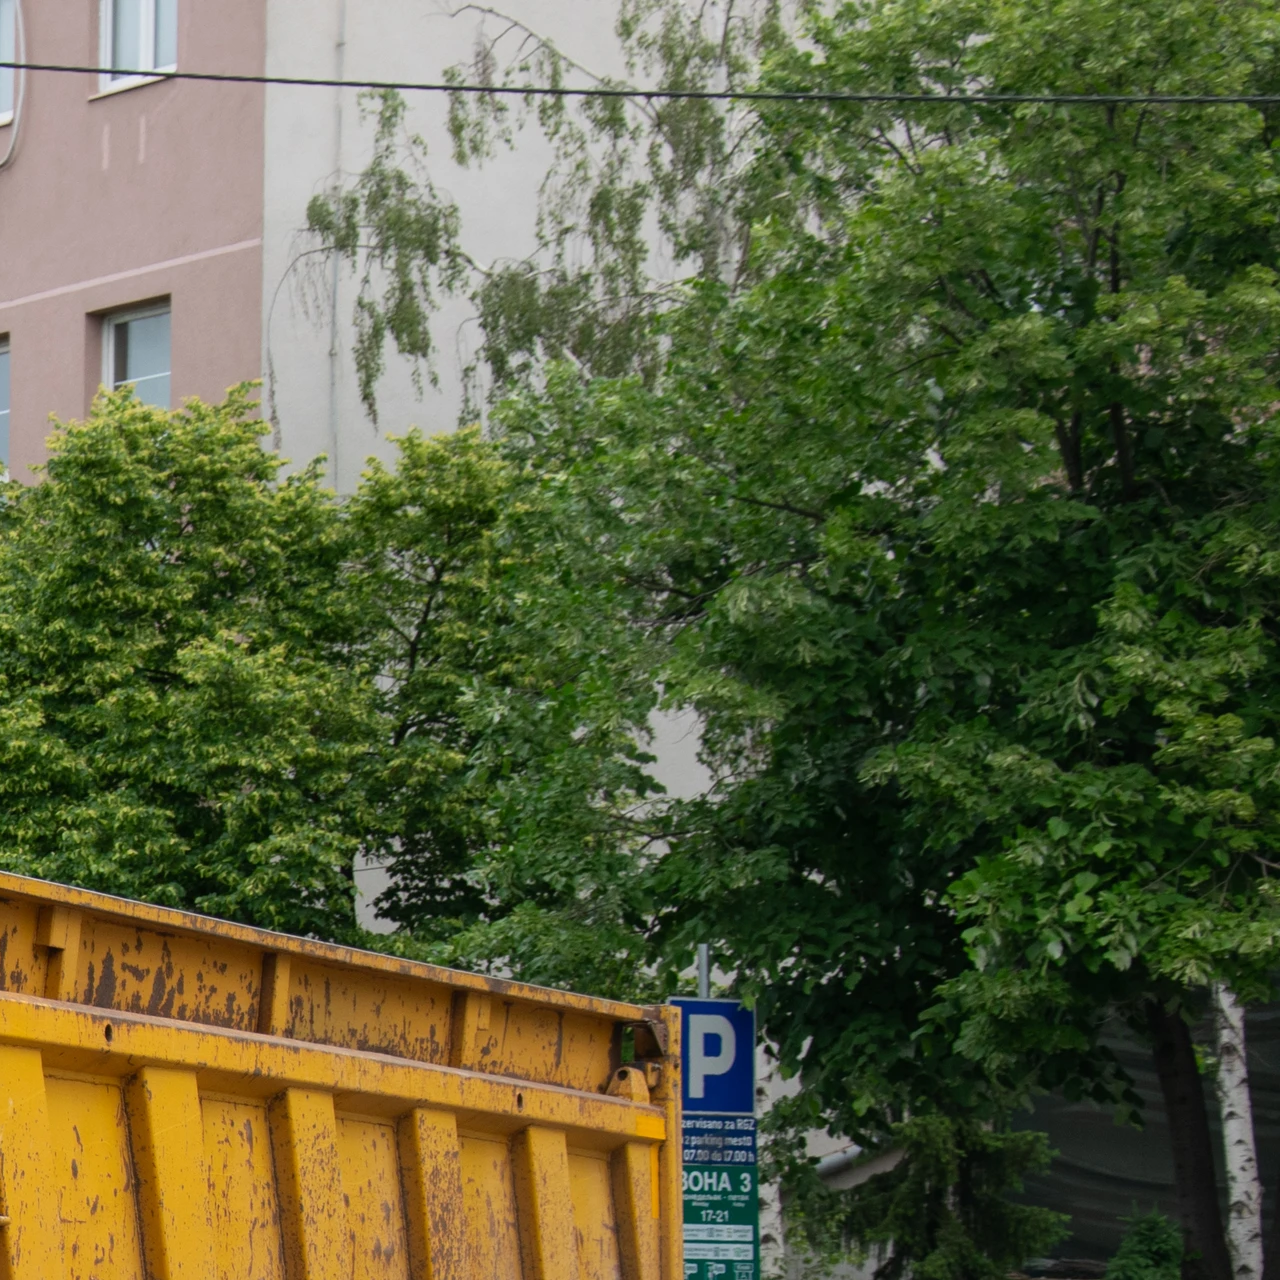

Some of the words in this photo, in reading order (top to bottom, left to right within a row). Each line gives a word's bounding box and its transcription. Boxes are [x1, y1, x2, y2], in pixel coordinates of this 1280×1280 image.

[688, 1013, 736, 1098] P
[681, 1117, 723, 1130] zervisano
[691, 1134, 723, 1148] parking
[740, 1172, 752, 1193] 3
[701, 1210, 729, 1222] 17-21
